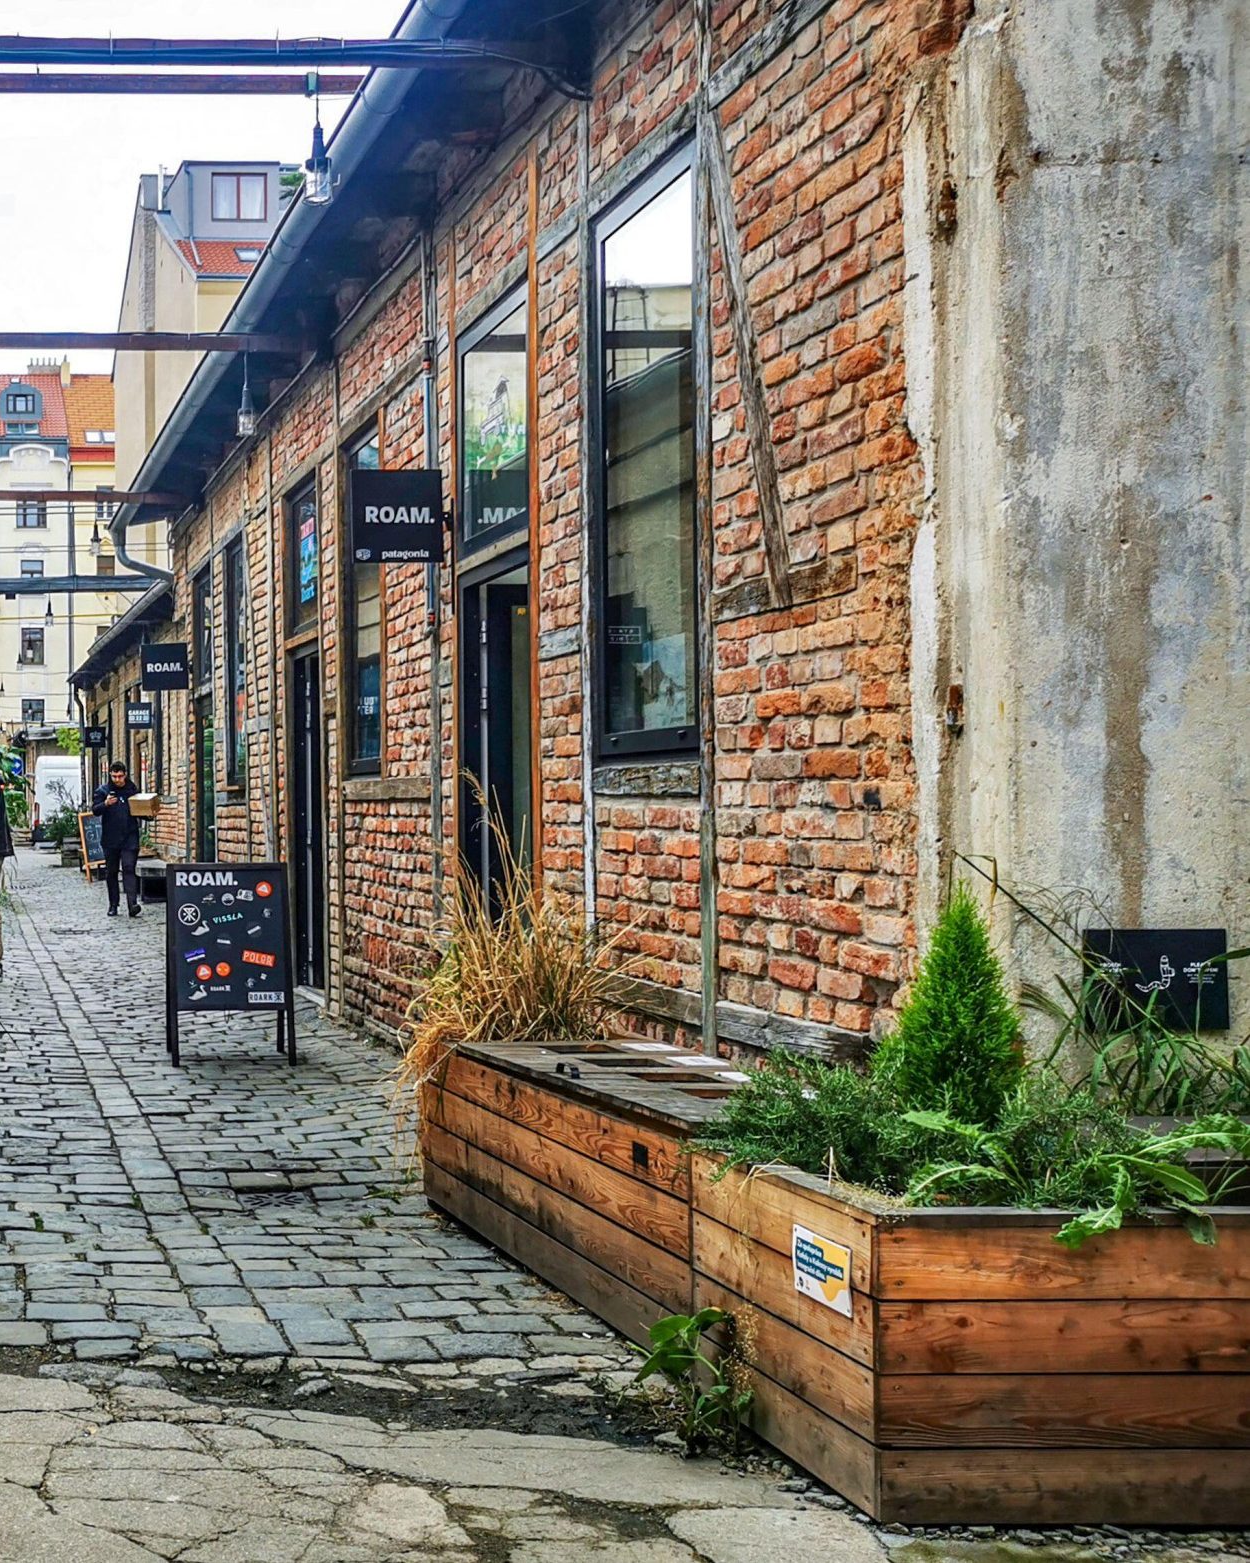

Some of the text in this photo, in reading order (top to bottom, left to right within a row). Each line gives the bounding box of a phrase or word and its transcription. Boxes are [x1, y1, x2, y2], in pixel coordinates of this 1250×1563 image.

[364, 505, 436, 524] ROAM.
[381, 548, 429, 560] patagonia
[146, 662, 184, 673] ROAM.
[175, 871, 239, 887] ROAM.
[212, 911, 244, 924] VISSLA
[249, 993, 273, 1001] ROARK
